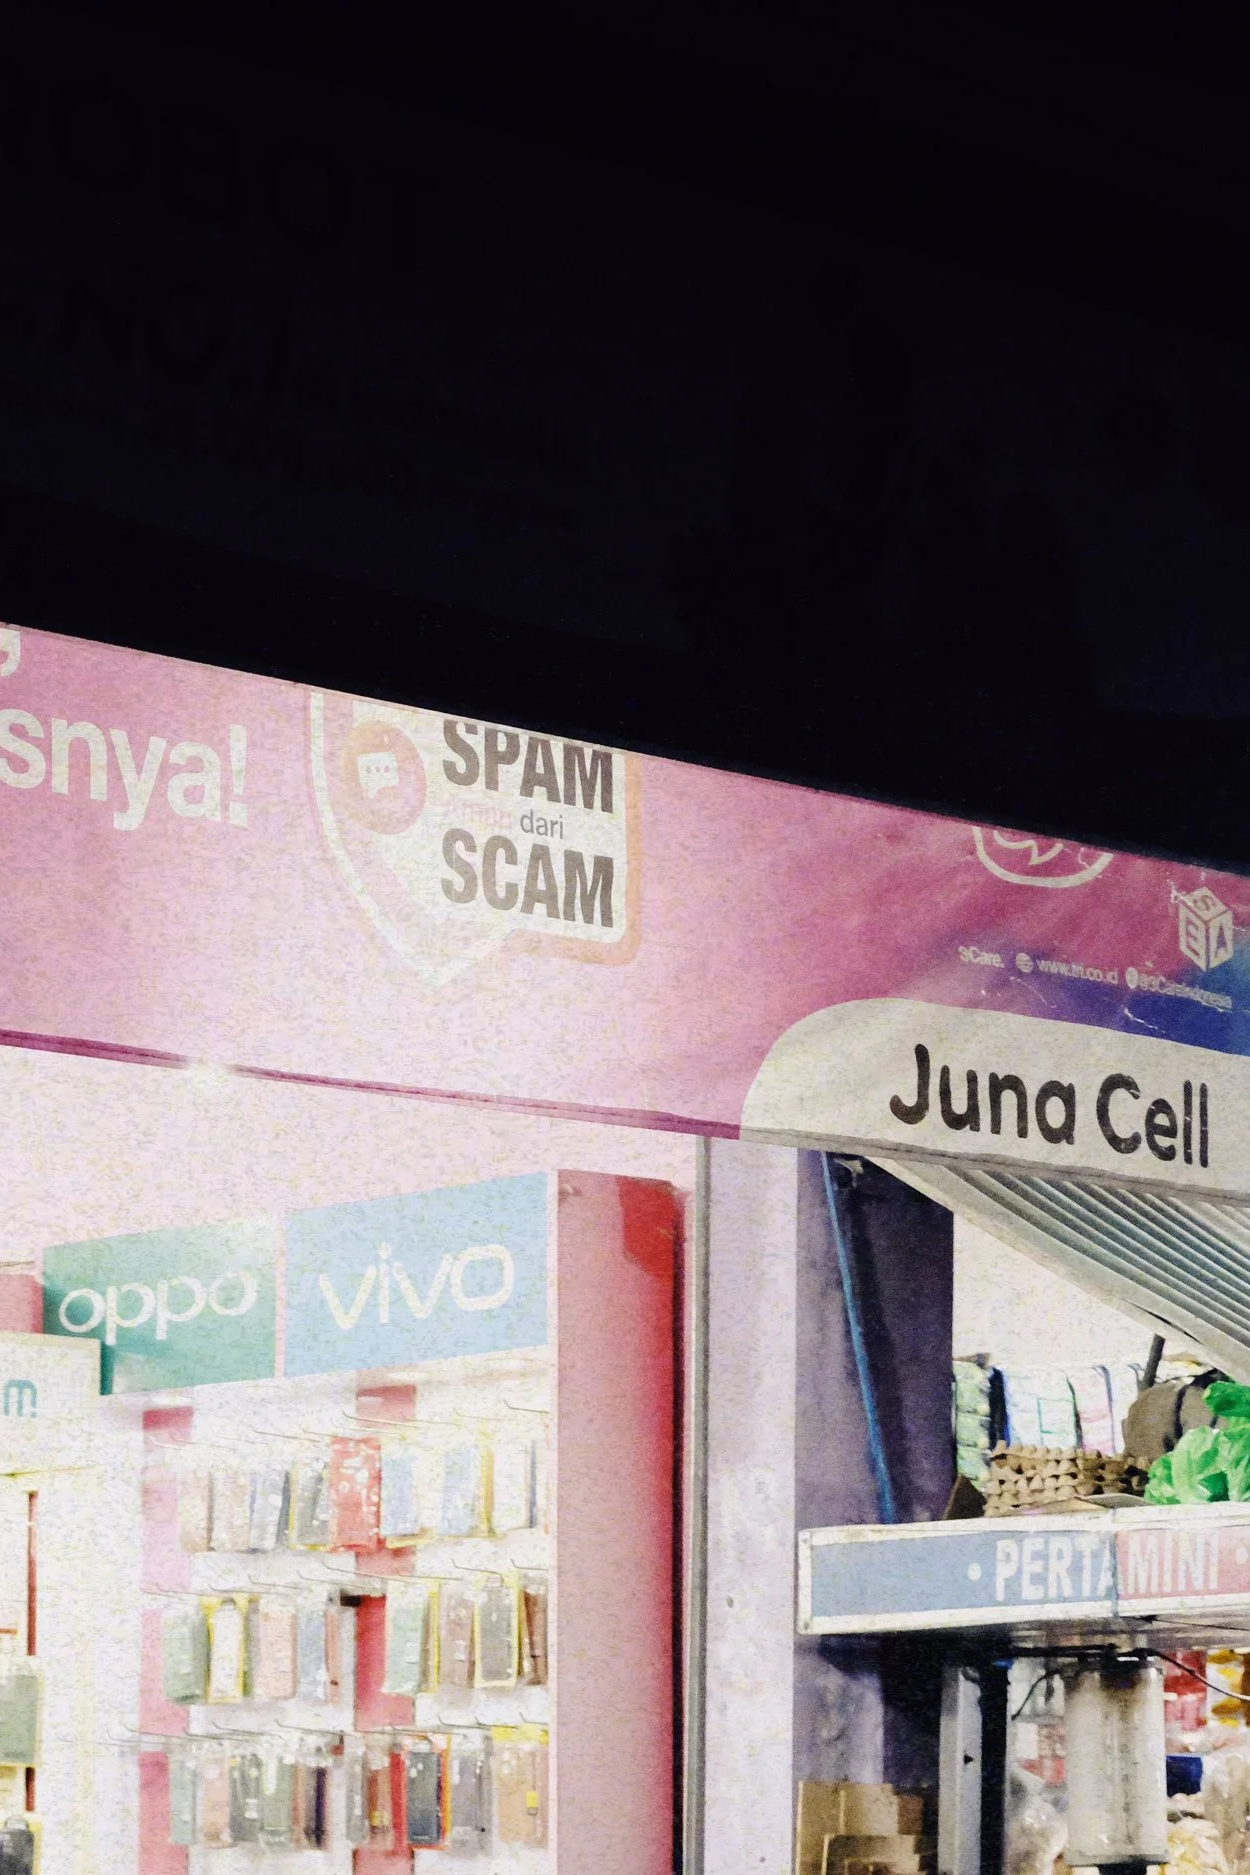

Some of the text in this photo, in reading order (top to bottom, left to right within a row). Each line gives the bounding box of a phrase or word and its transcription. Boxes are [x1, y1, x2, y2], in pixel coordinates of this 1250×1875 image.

[442, 717, 615, 814] SPAM
[519, 808, 565, 840] dari
[441, 827, 615, 929] SCAM
[889, 1042, 1209, 1169] Juna Cell
[58, 1268, 258, 1346] oppo
[318, 1242, 515, 1330] vivo
